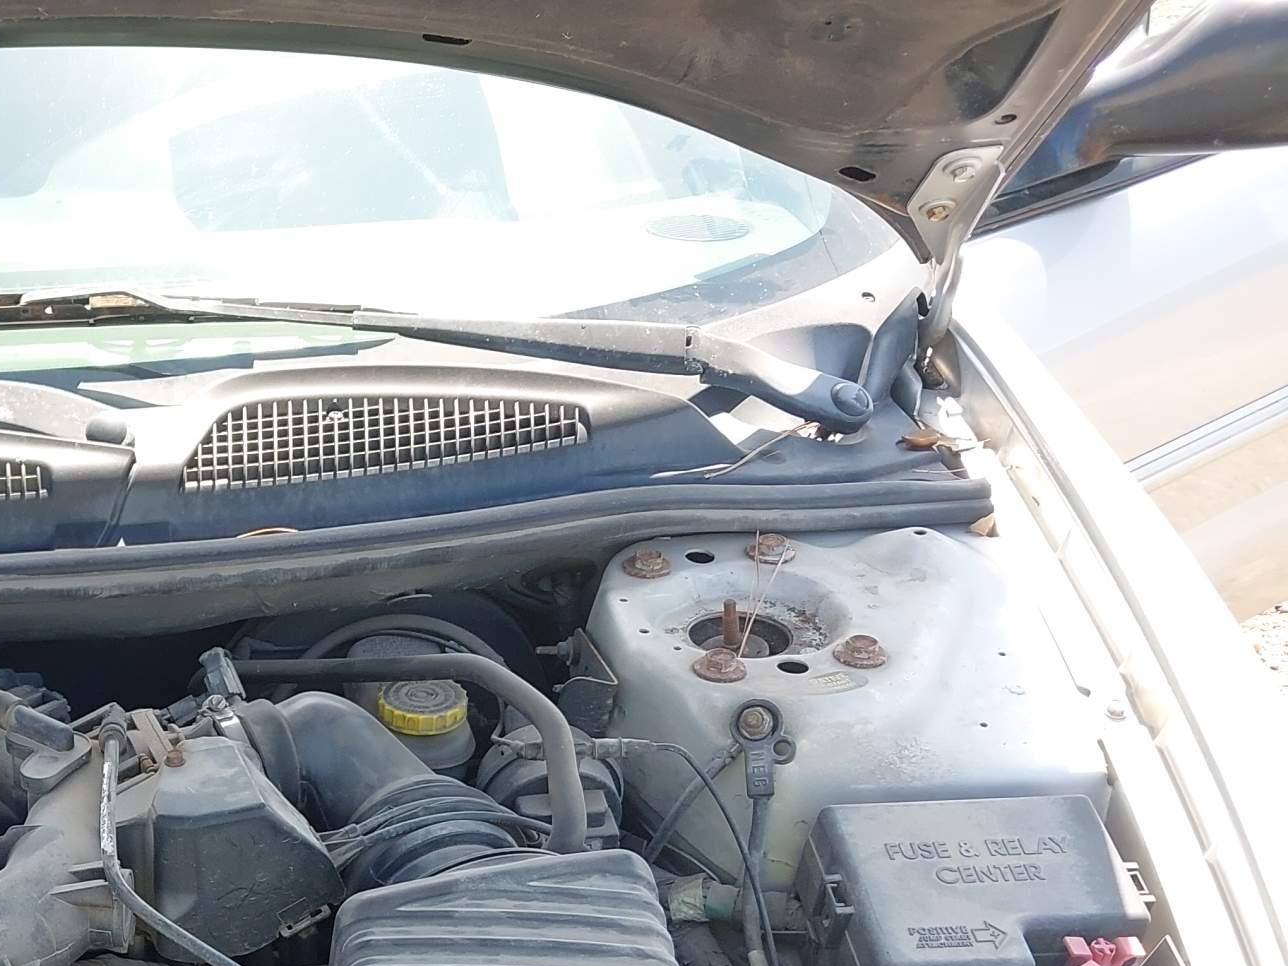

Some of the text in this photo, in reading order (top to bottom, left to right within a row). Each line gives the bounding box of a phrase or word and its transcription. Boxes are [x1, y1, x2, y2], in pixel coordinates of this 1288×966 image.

[750, 751, 770, 788] NEG
[883, 836, 1068, 861] FUSE & RELAY
[935, 863, 1047, 885] CENTER
[907, 926, 970, 937] POSITIVE
